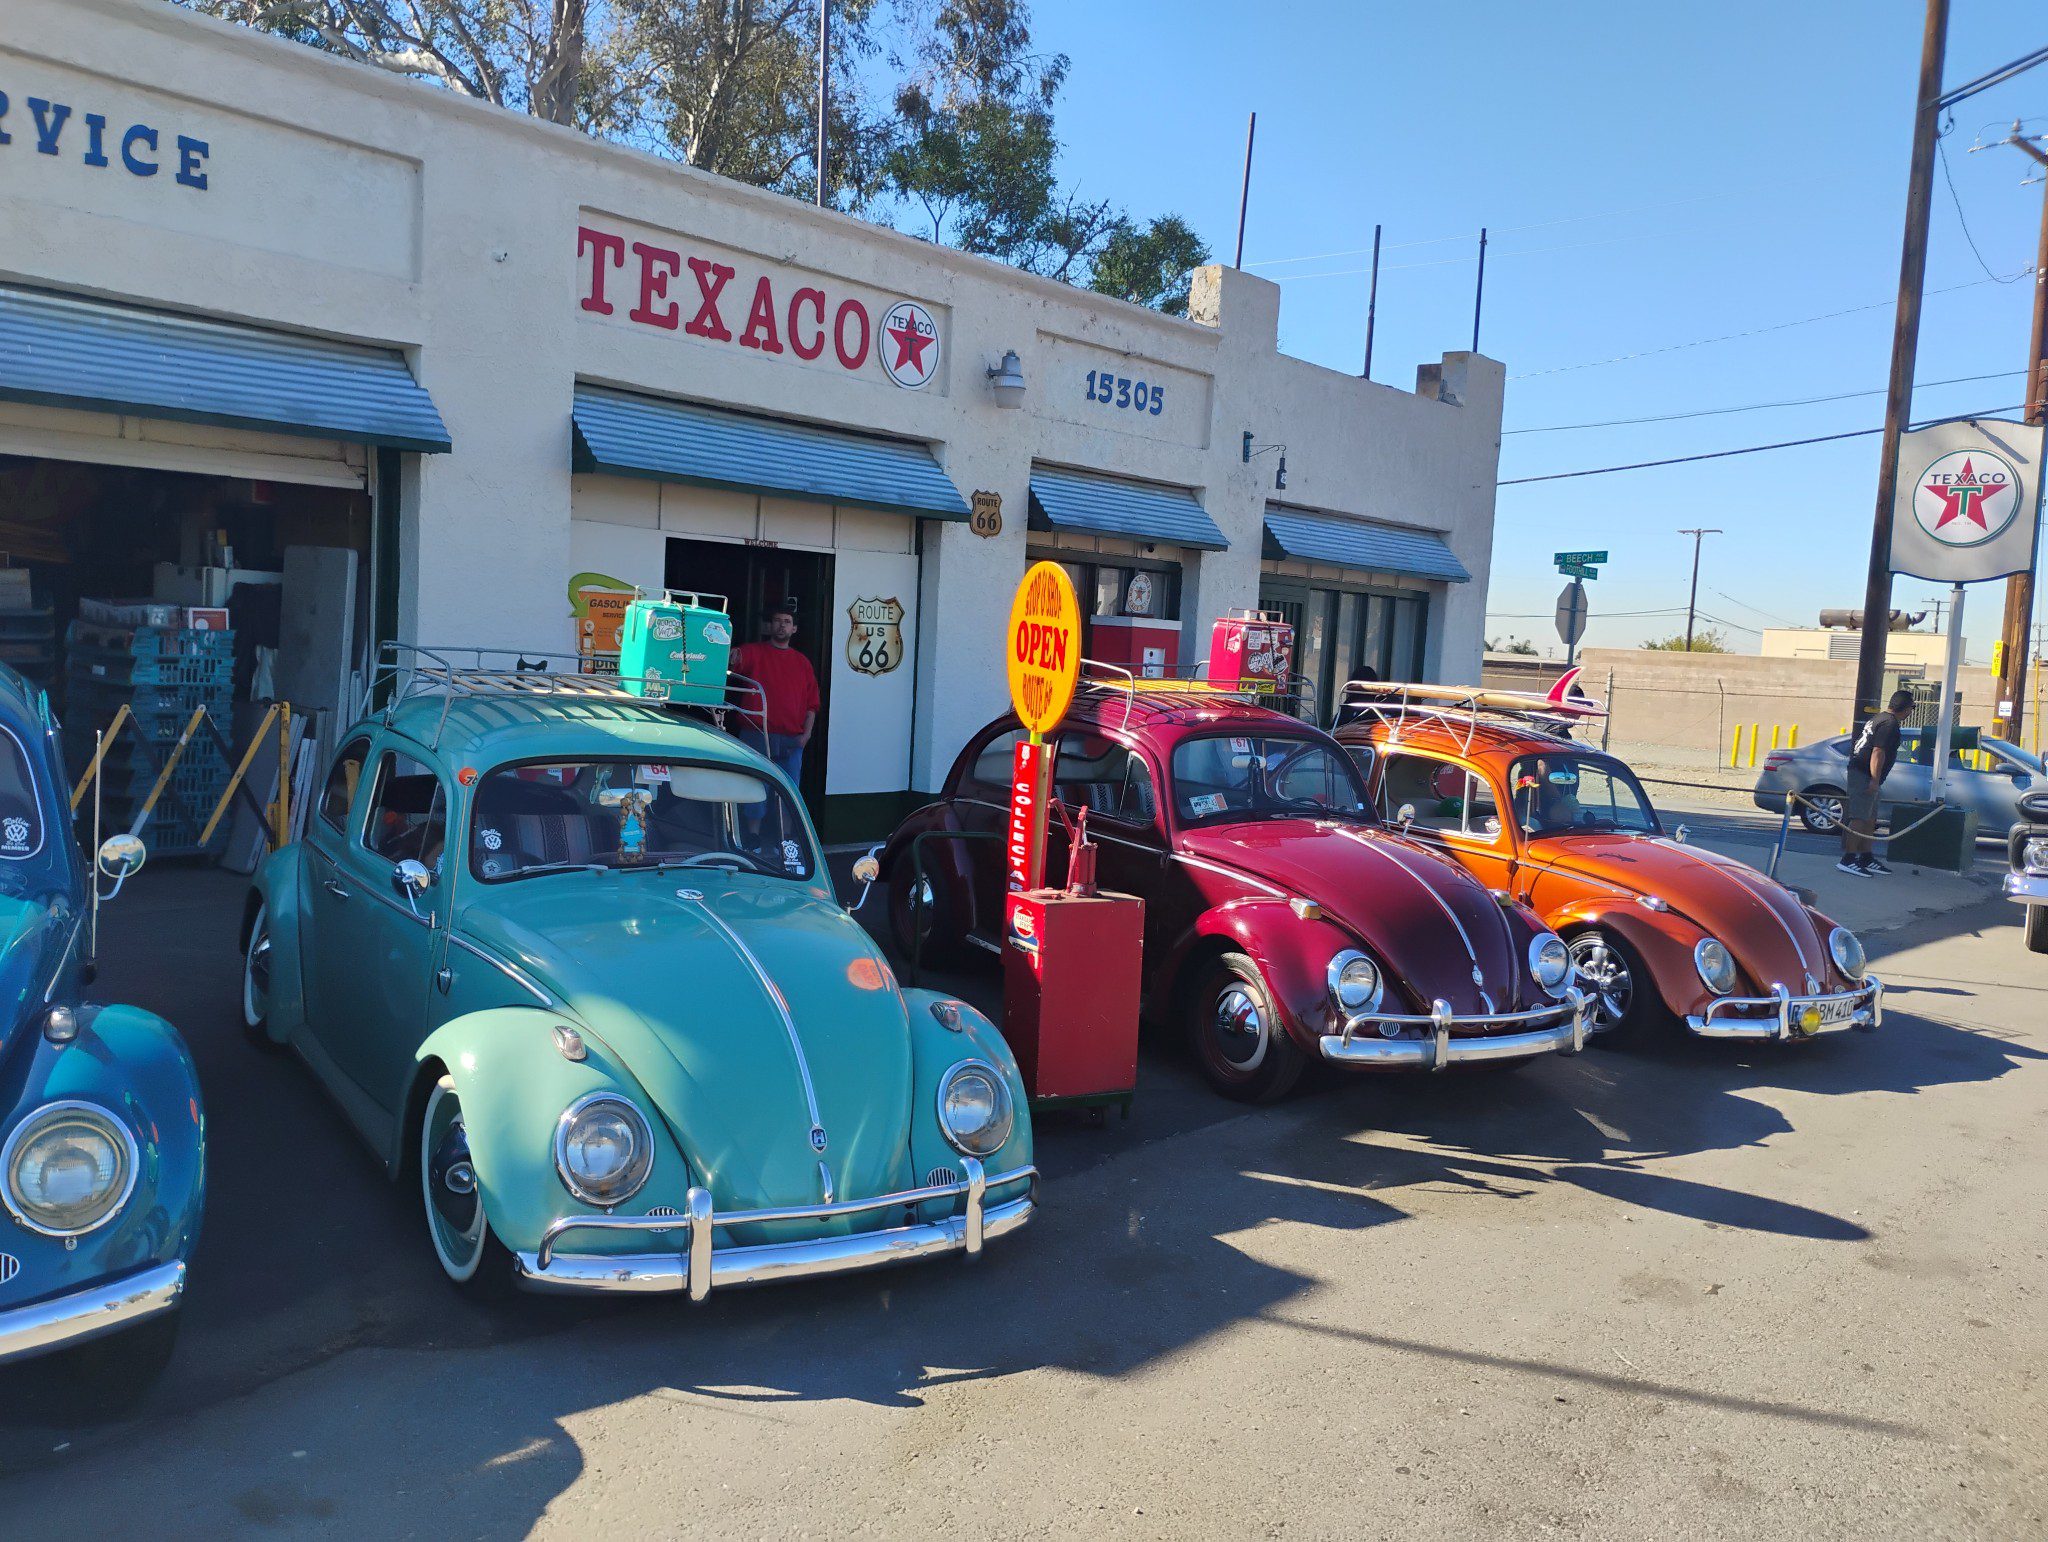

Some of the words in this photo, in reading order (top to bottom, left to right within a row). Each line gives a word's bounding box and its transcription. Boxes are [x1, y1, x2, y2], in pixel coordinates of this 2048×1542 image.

[578, 226, 870, 370] TEXACO
[892, 315, 933, 335] TEXACO
[1086, 370, 1164, 415] 15305
[1931, 473, 2006, 484] TEXACO
[977, 498, 997, 507] ROUTE
[1948, 486, 1983, 515] T
[977, 511, 996, 530] 66
[1567, 553, 1593, 563] BEECH
[1025, 571, 1041, 616] STOP
[1047, 571, 1061, 619] SHOP
[858, 606, 894, 620] ROUTE
[866, 627, 885, 637] US
[859, 640, 889, 668] 66
[1016, 620, 1069, 673] OPEN
[1022, 673, 1044, 719] ROUTE
[1236, 737, 1246, 748] 67
[651, 764, 669, 775] 64
